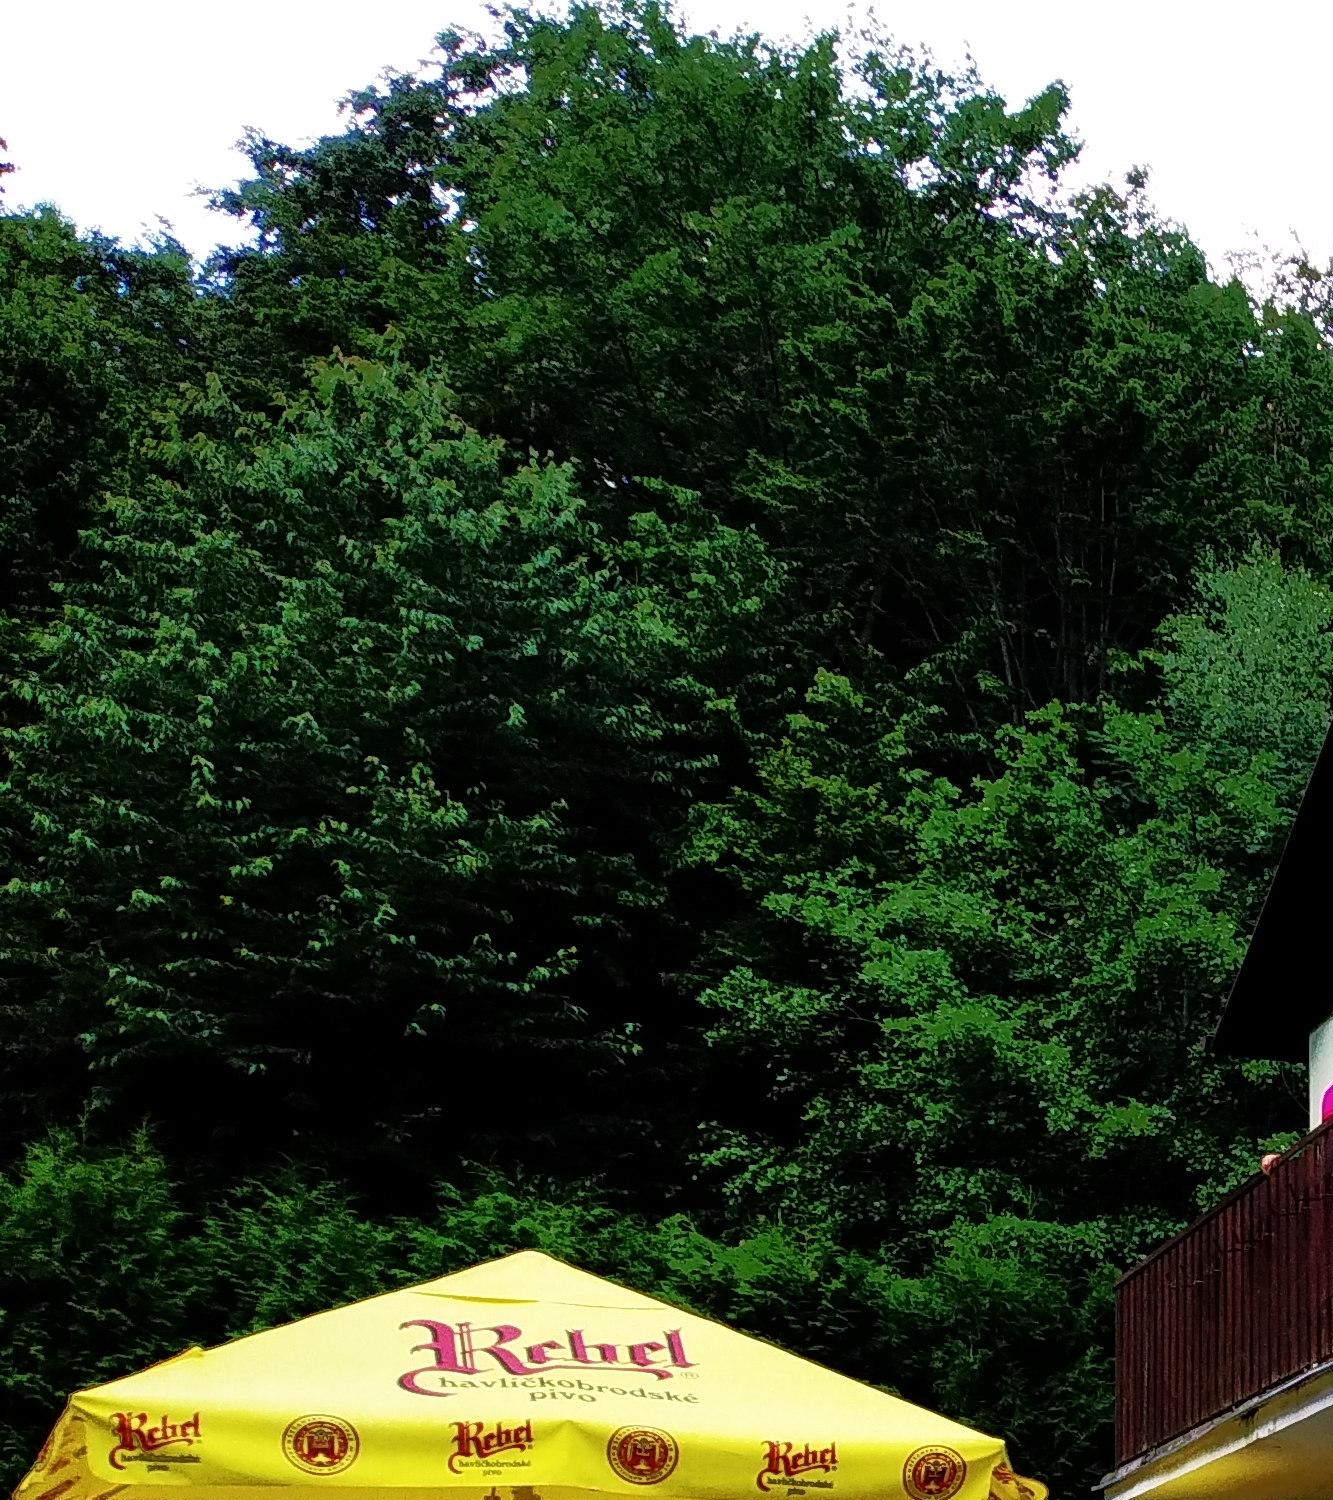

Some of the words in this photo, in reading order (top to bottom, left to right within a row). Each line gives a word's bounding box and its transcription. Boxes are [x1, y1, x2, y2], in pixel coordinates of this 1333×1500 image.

[396, 1319, 699, 1397] Rebel
[439, 1376, 700, 1404] havlíčkobrodské
[529, 1389, 597, 1403] pivo
[109, 1412, 200, 1470] Rebel
[448, 1419, 533, 1474] Rebel
[757, 1441, 837, 1492] Rebel
